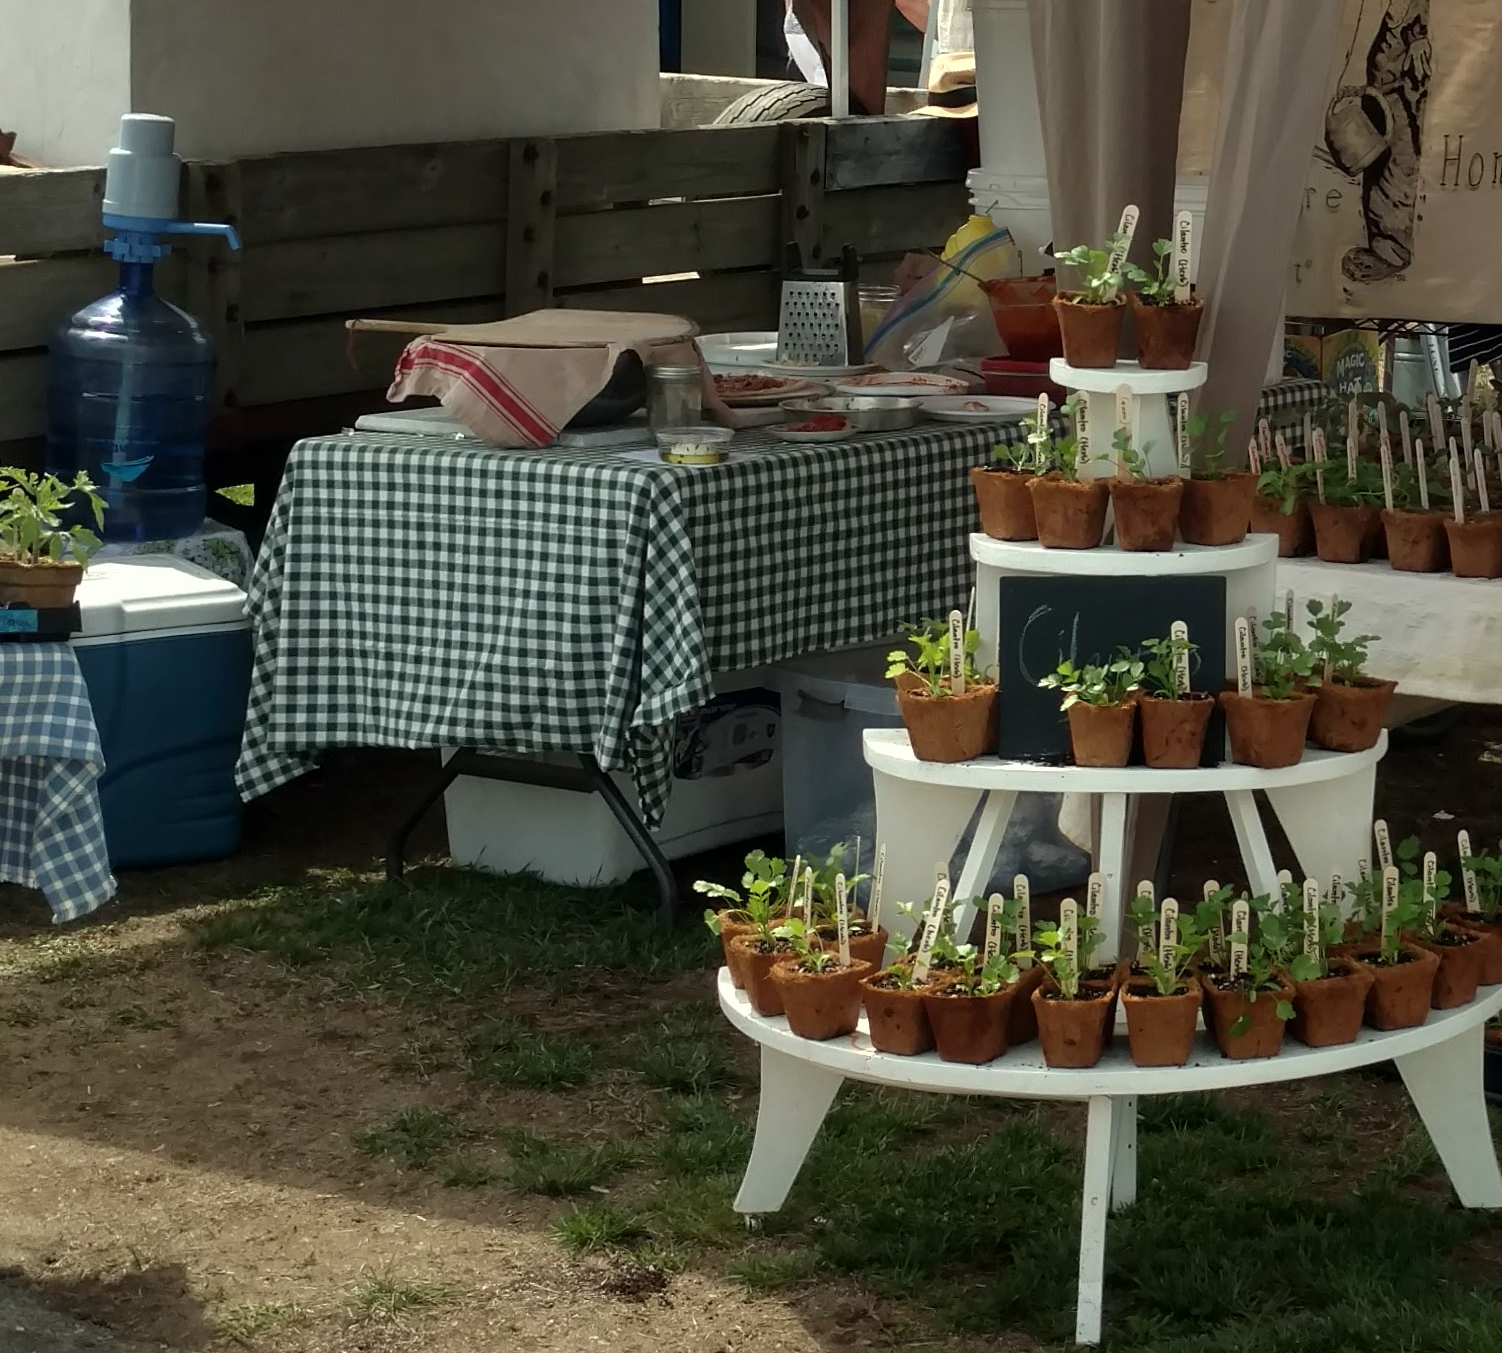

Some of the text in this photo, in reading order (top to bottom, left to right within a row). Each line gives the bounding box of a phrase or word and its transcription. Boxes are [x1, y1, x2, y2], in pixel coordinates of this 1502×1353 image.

[1179, 220, 1191, 254] Cilantro
[1336, 352, 1365, 379] MAGIC
[1237, 625, 1247, 660] Cilantro
[931, 885, 947, 919] Cilantro
